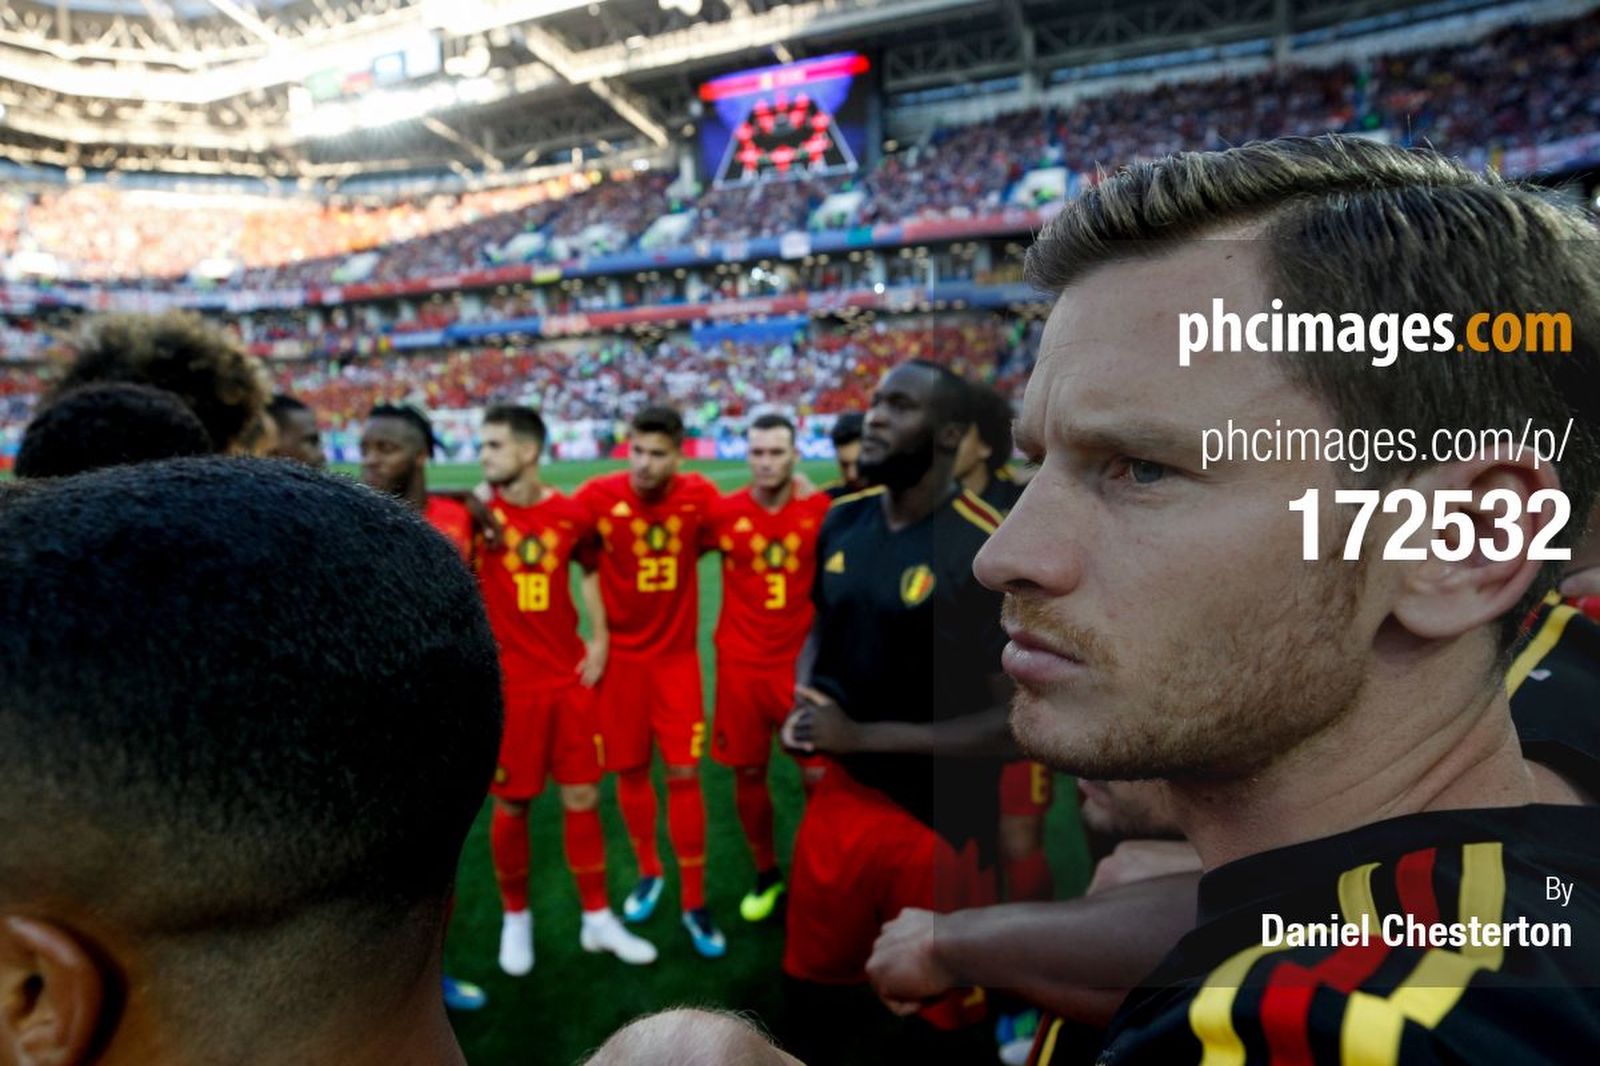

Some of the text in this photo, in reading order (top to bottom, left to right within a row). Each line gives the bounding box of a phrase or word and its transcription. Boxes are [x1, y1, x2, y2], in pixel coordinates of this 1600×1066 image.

[637, 556, 677, 592] 23
[764, 573, 786, 609] 3
[512, 573, 550, 612] 18
